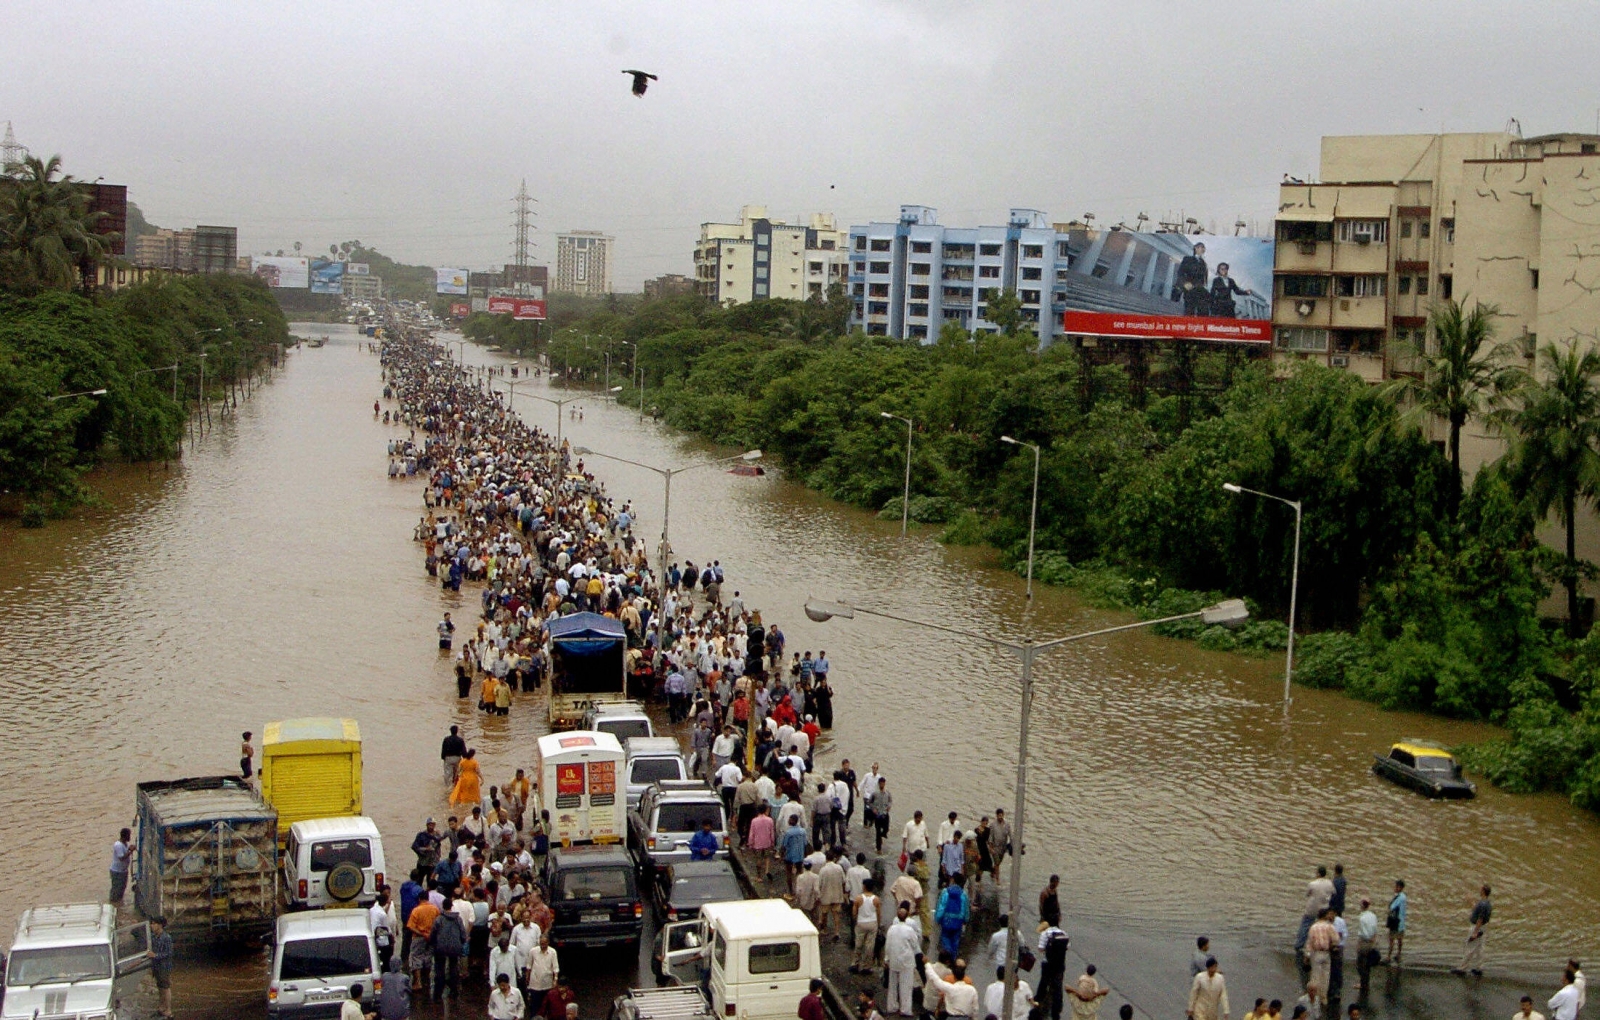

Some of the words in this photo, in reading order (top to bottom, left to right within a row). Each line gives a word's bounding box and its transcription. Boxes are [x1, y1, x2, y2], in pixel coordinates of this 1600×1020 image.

[1113, 321, 1125, 329] see
[1126, 321, 1155, 330] mumbai
[1187, 323, 1204, 333] light
[1207, 324, 1240, 333] Hindustan
[1241, 326, 1261, 335] Times
